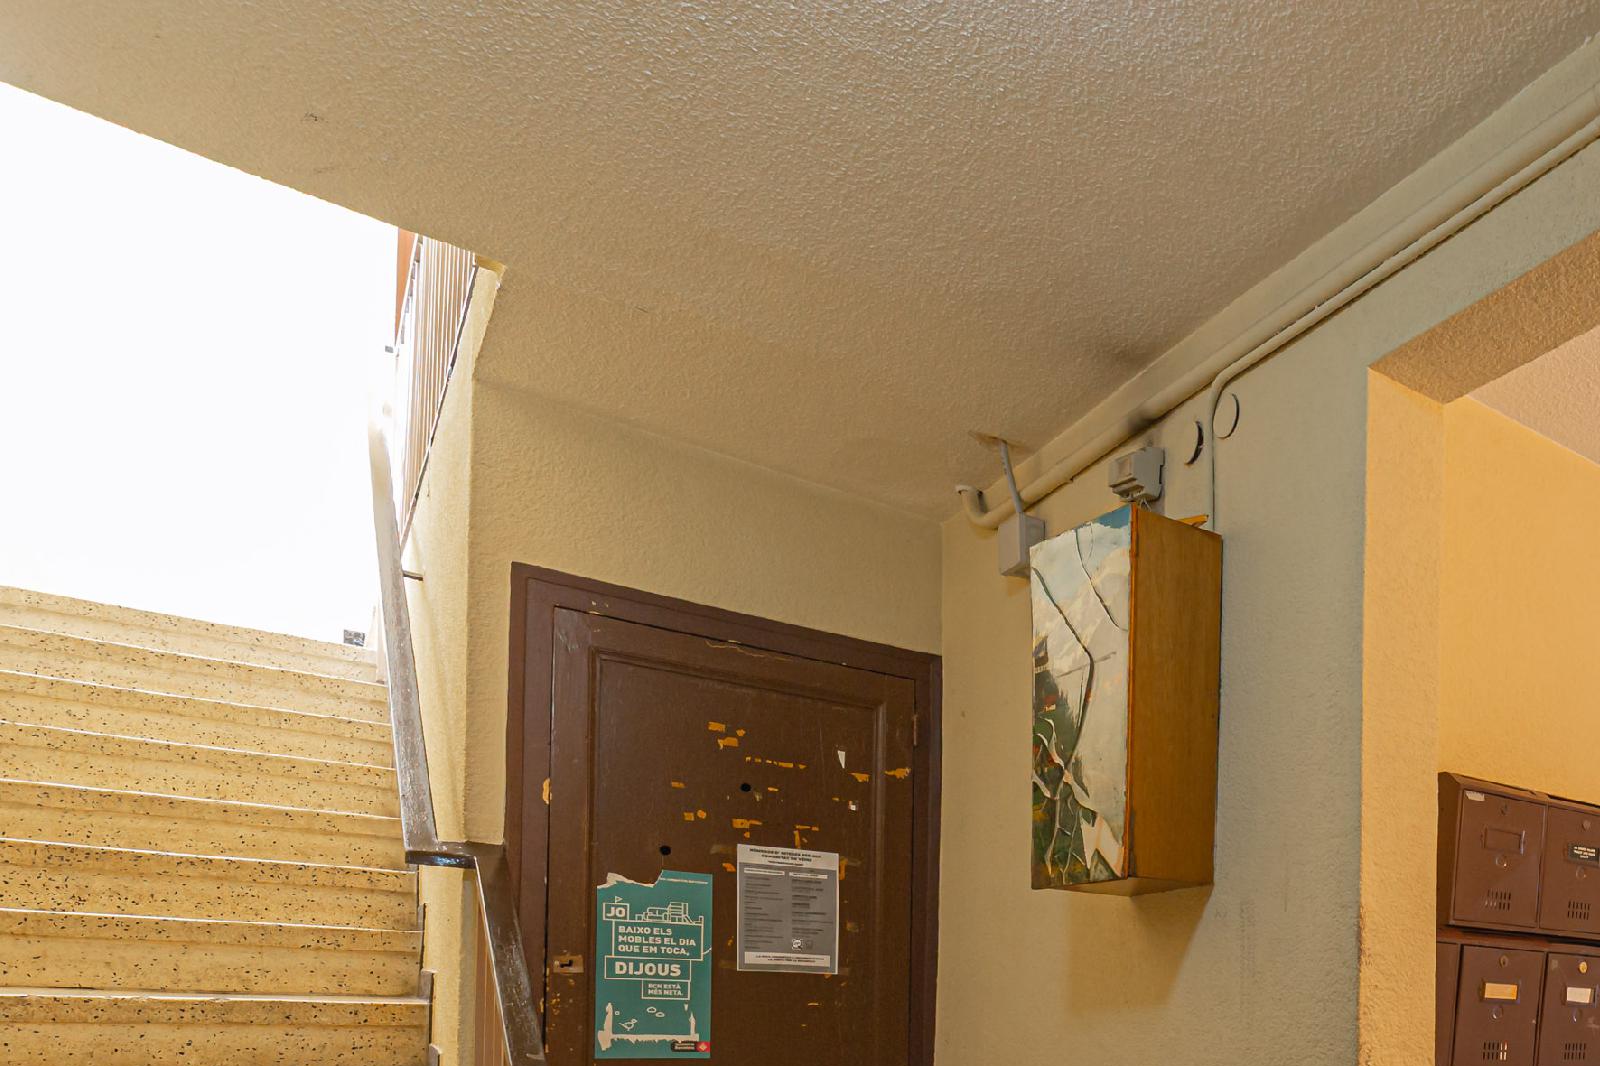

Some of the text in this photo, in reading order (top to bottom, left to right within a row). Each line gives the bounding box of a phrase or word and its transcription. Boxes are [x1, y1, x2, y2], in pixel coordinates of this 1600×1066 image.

[606, 907, 626, 917] JO
[618, 926, 651, 934] BAIXO
[618, 935, 662, 944] MOBLES
[679, 938, 696, 946] DIA
[618, 944, 690, 956] QUE EM TOCA,
[615, 961, 681, 977] DIJOUS
